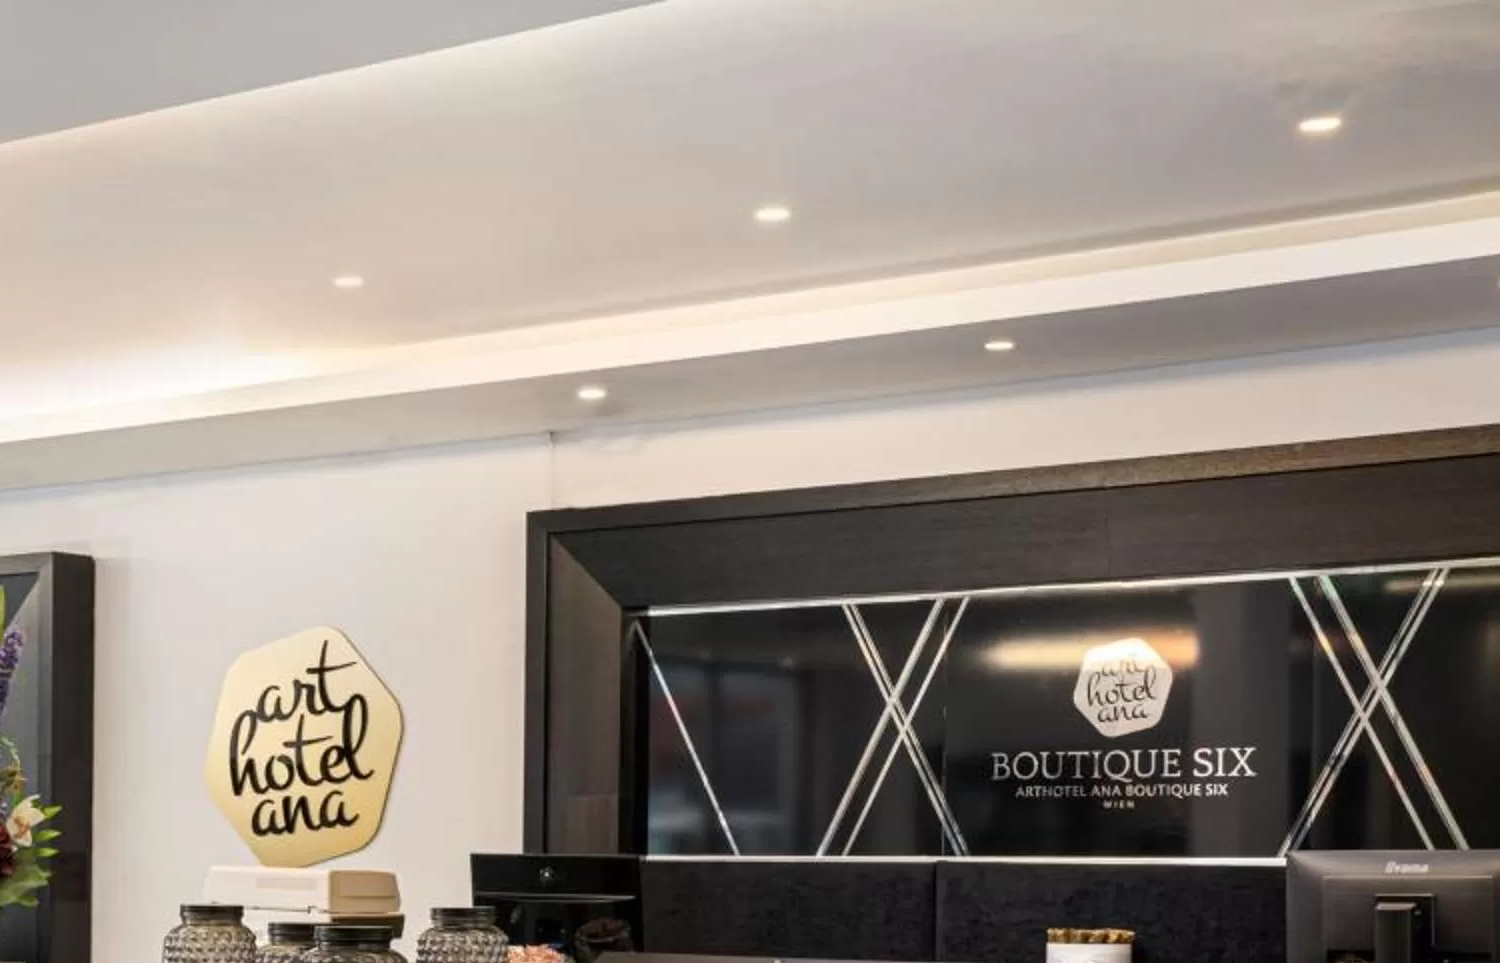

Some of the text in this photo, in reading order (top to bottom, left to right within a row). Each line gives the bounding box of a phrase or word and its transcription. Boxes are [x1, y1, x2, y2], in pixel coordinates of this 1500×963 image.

[256, 640, 357, 722] art
[1088, 665, 1156, 707] hotel
[1098, 704, 1149, 722] ana
[229, 694, 374, 796] hotel
[991, 747, 1257, 782] BOUTIQUE SIX
[1016, 783, 1229, 798] ARTHOTEL ANA BOUTIQUE SIX
[1103, 800, 1136, 808] WIEN
[252, 790, 359, 836] ana
